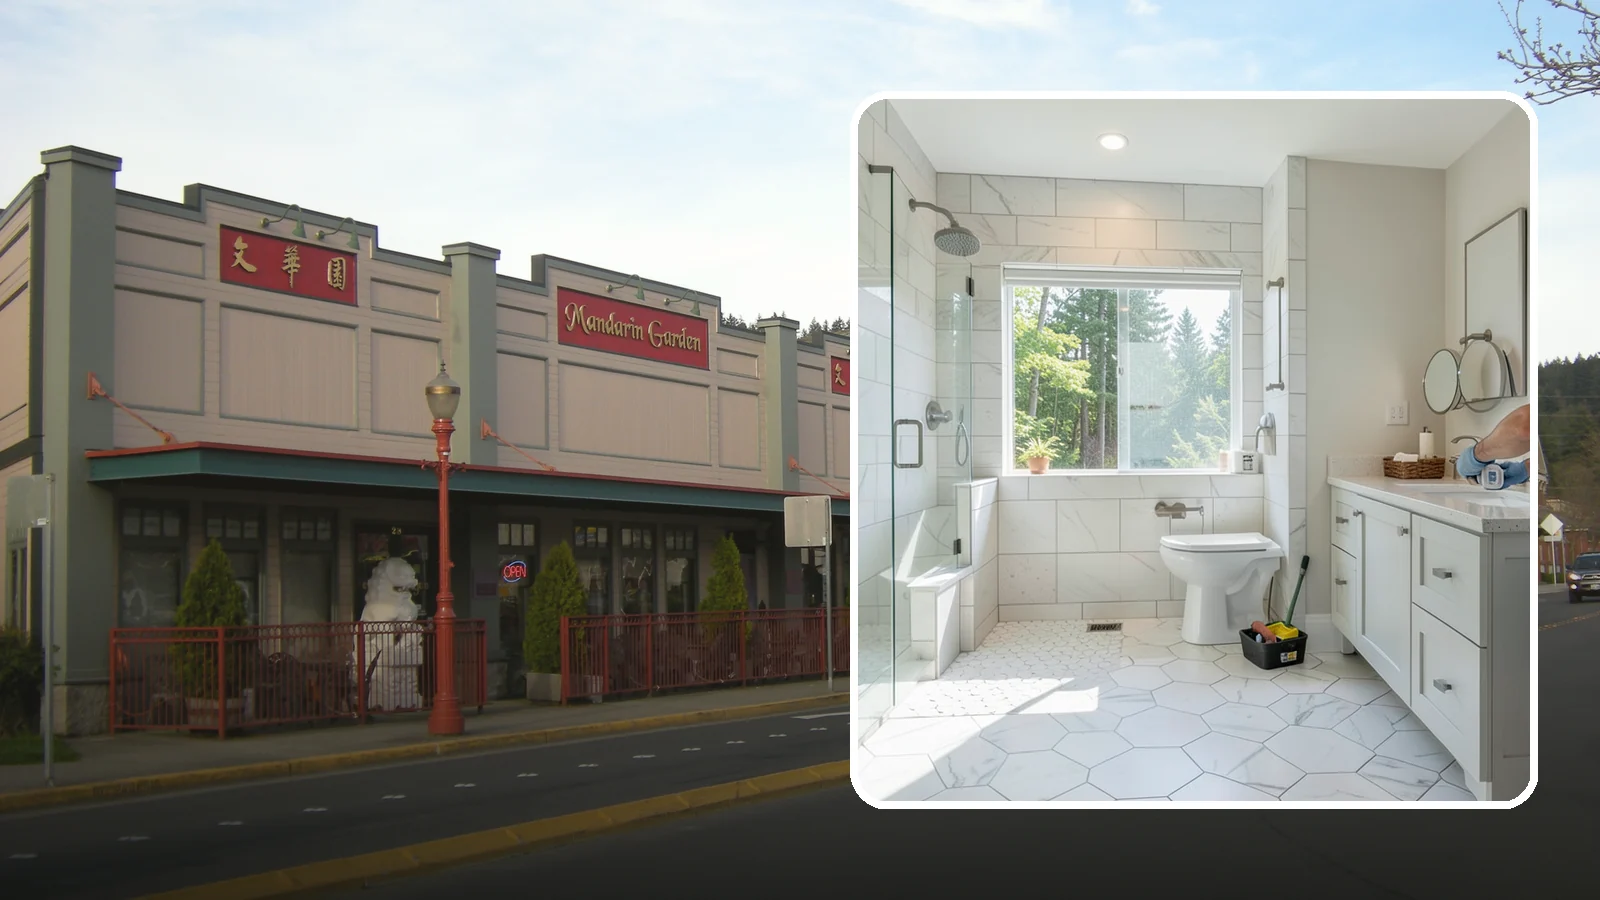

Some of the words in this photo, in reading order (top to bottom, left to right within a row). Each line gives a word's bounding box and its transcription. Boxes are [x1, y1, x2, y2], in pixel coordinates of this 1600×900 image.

[231, 236, 346, 291] 文華園
[564, 302, 644, 341] Mandarin
[647, 320, 701, 352] Garden
[503, 565, 527, 578] OPEN
